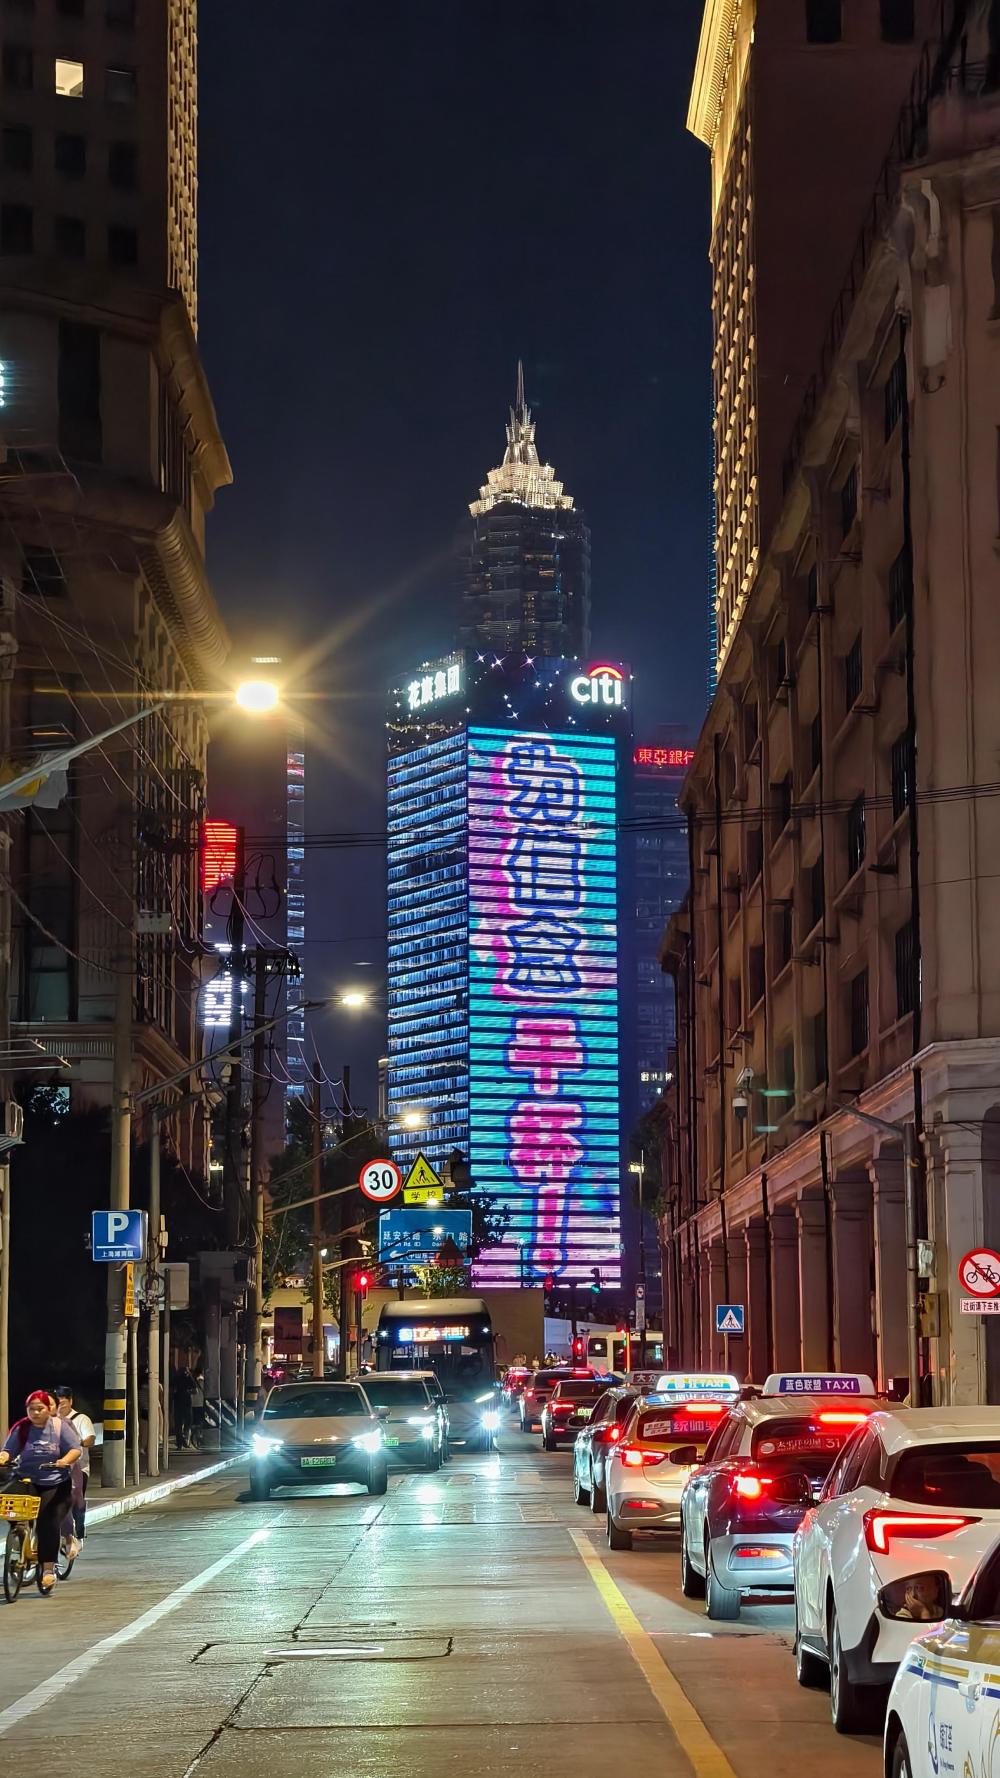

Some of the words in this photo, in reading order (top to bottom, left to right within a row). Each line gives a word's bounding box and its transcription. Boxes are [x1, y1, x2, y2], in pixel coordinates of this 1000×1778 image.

[368, 1169, 394, 1191] 30
[107, 1212, 129, 1243] P
[785, 1379, 821, 1391] 蓝色联盟
[825, 1380, 854, 1390] TAXI
